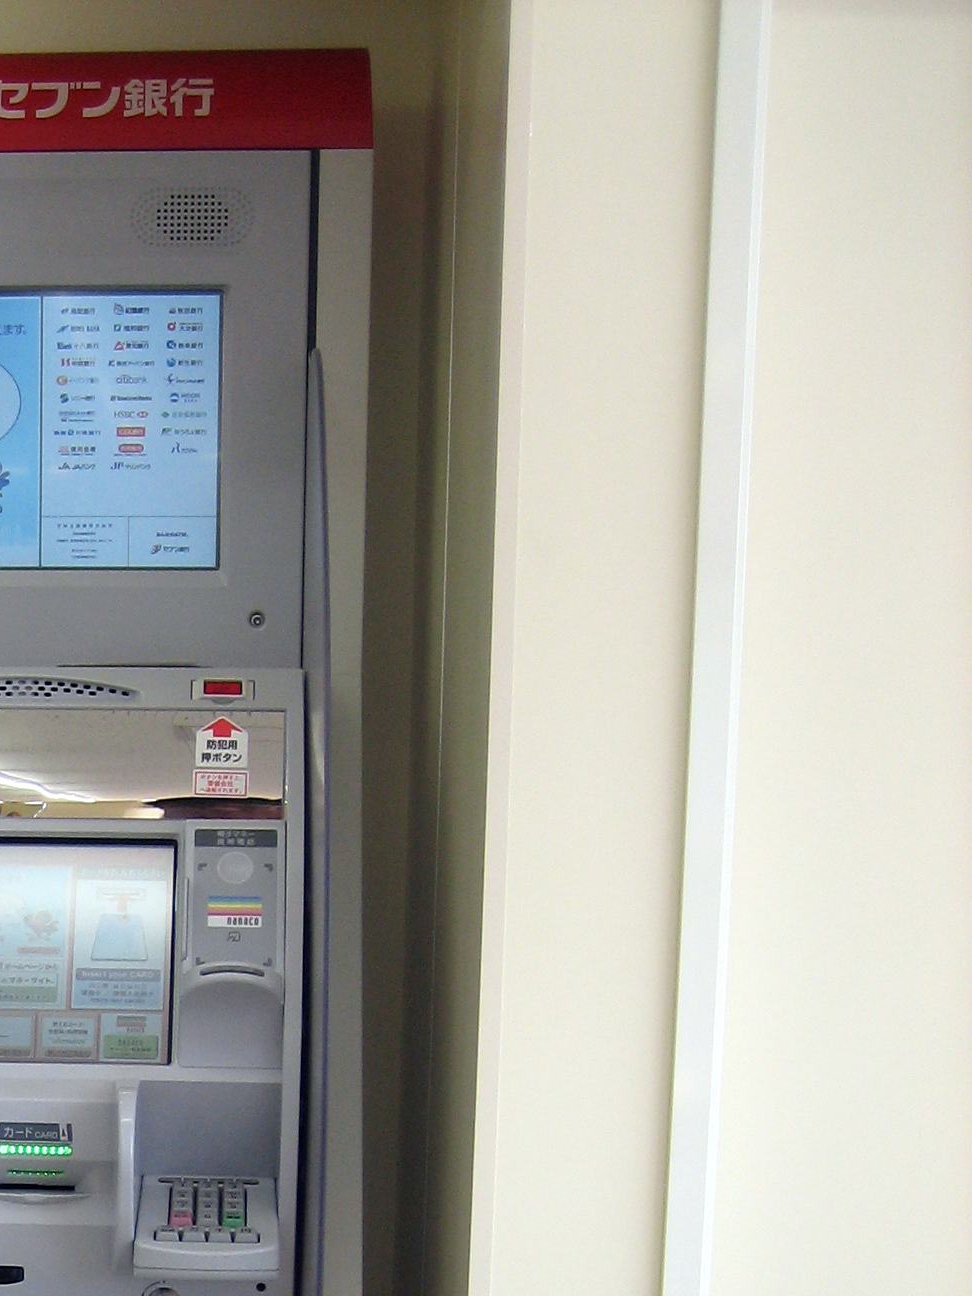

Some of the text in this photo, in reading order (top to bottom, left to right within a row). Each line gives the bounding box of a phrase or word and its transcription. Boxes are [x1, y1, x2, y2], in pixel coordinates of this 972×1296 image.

[206, 739, 239, 751] 防犯用
[200, 752, 243, 763] 押ボタン
[226, 916, 260, 927] nanaco
[2, 1125, 60, 1139] カード CARD
